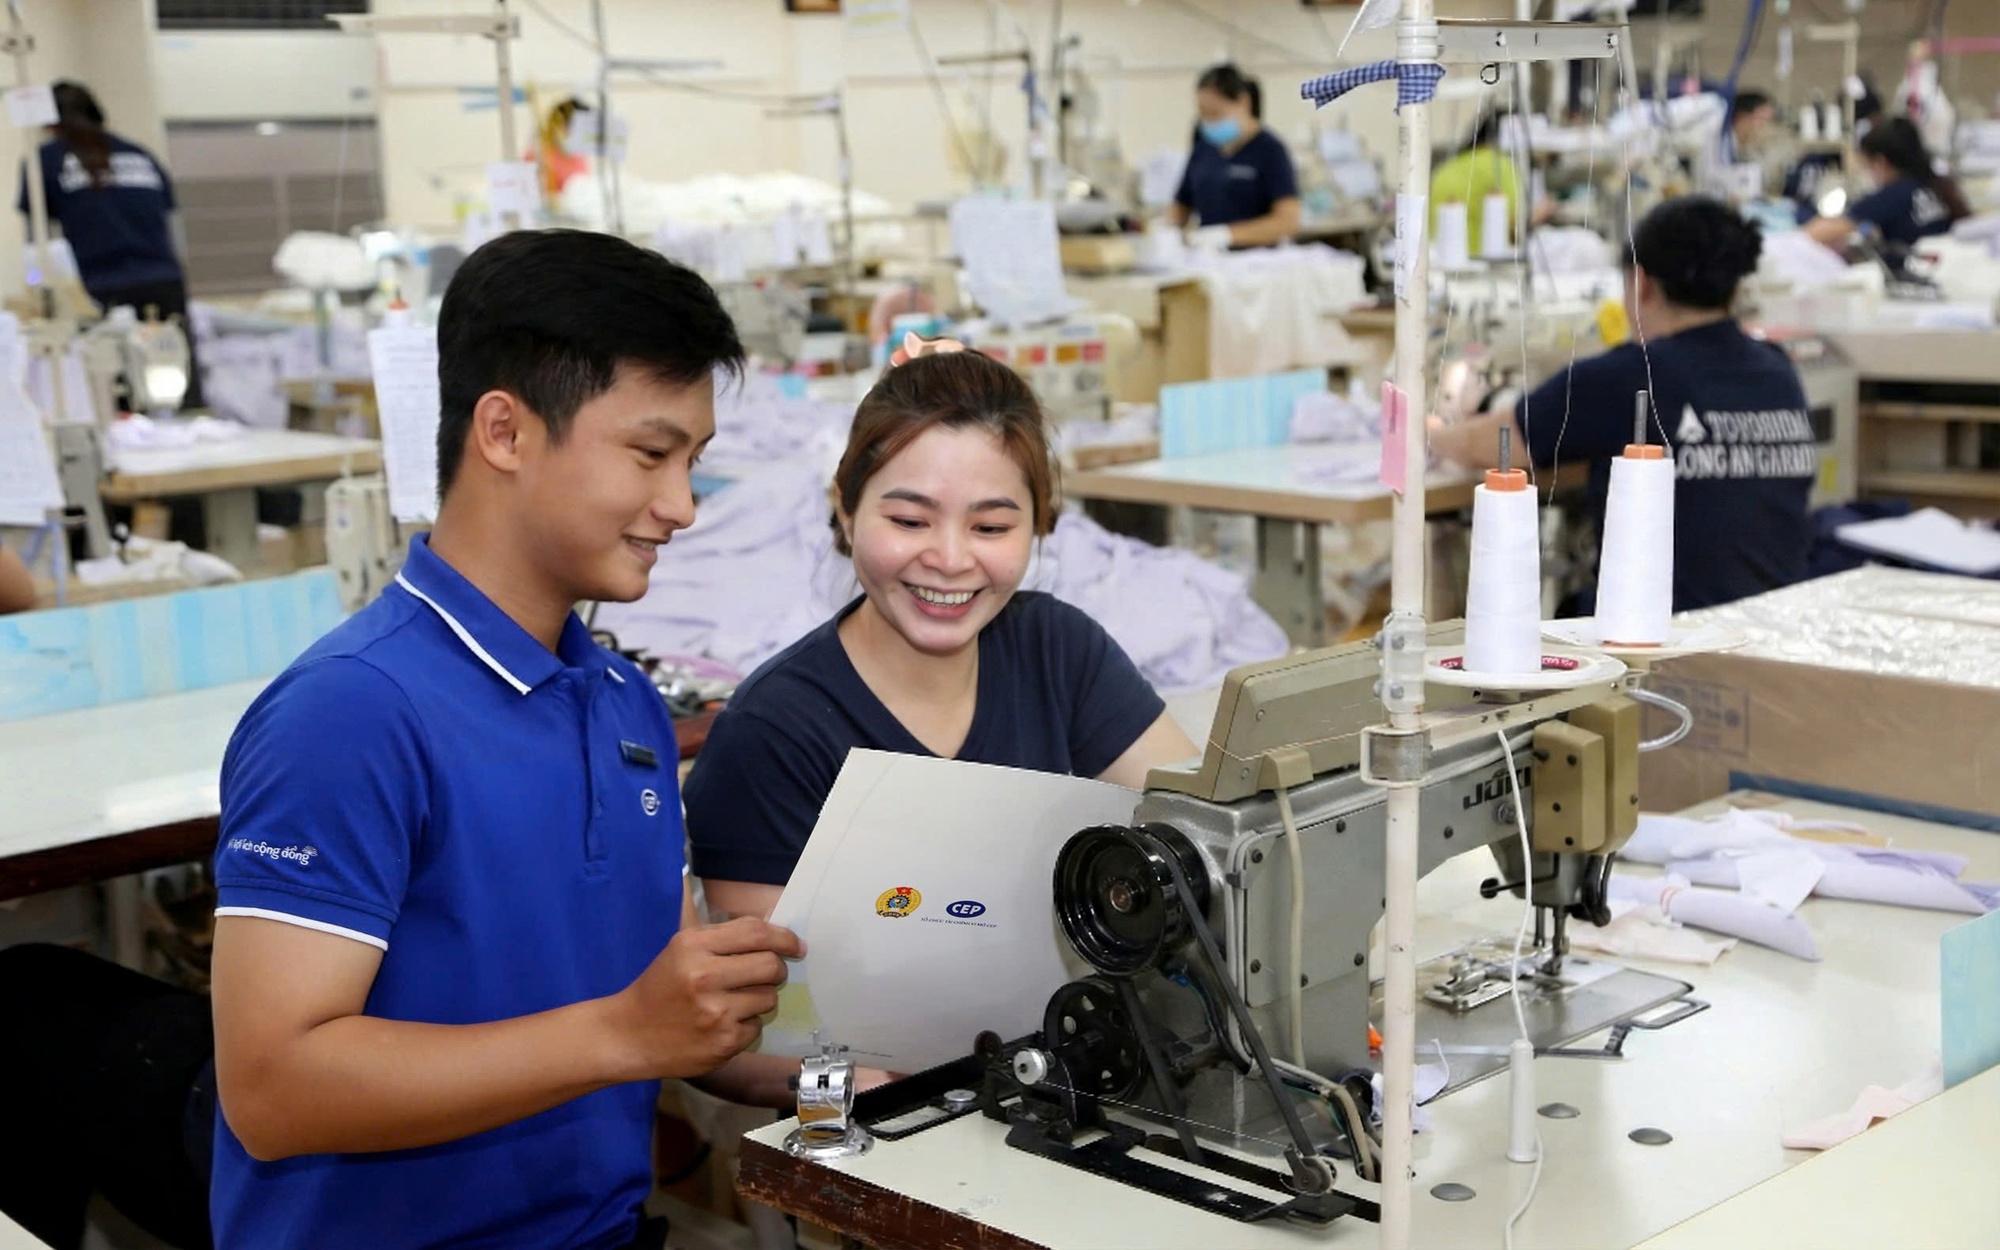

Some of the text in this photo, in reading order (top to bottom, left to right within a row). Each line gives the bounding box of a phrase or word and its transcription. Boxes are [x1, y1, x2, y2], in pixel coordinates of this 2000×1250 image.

[1675, 443, 1728, 480] ONG
[253, 841, 281, 860] cộng
[281, 846, 310, 866] đồng
[951, 903, 982, 915] CEP
